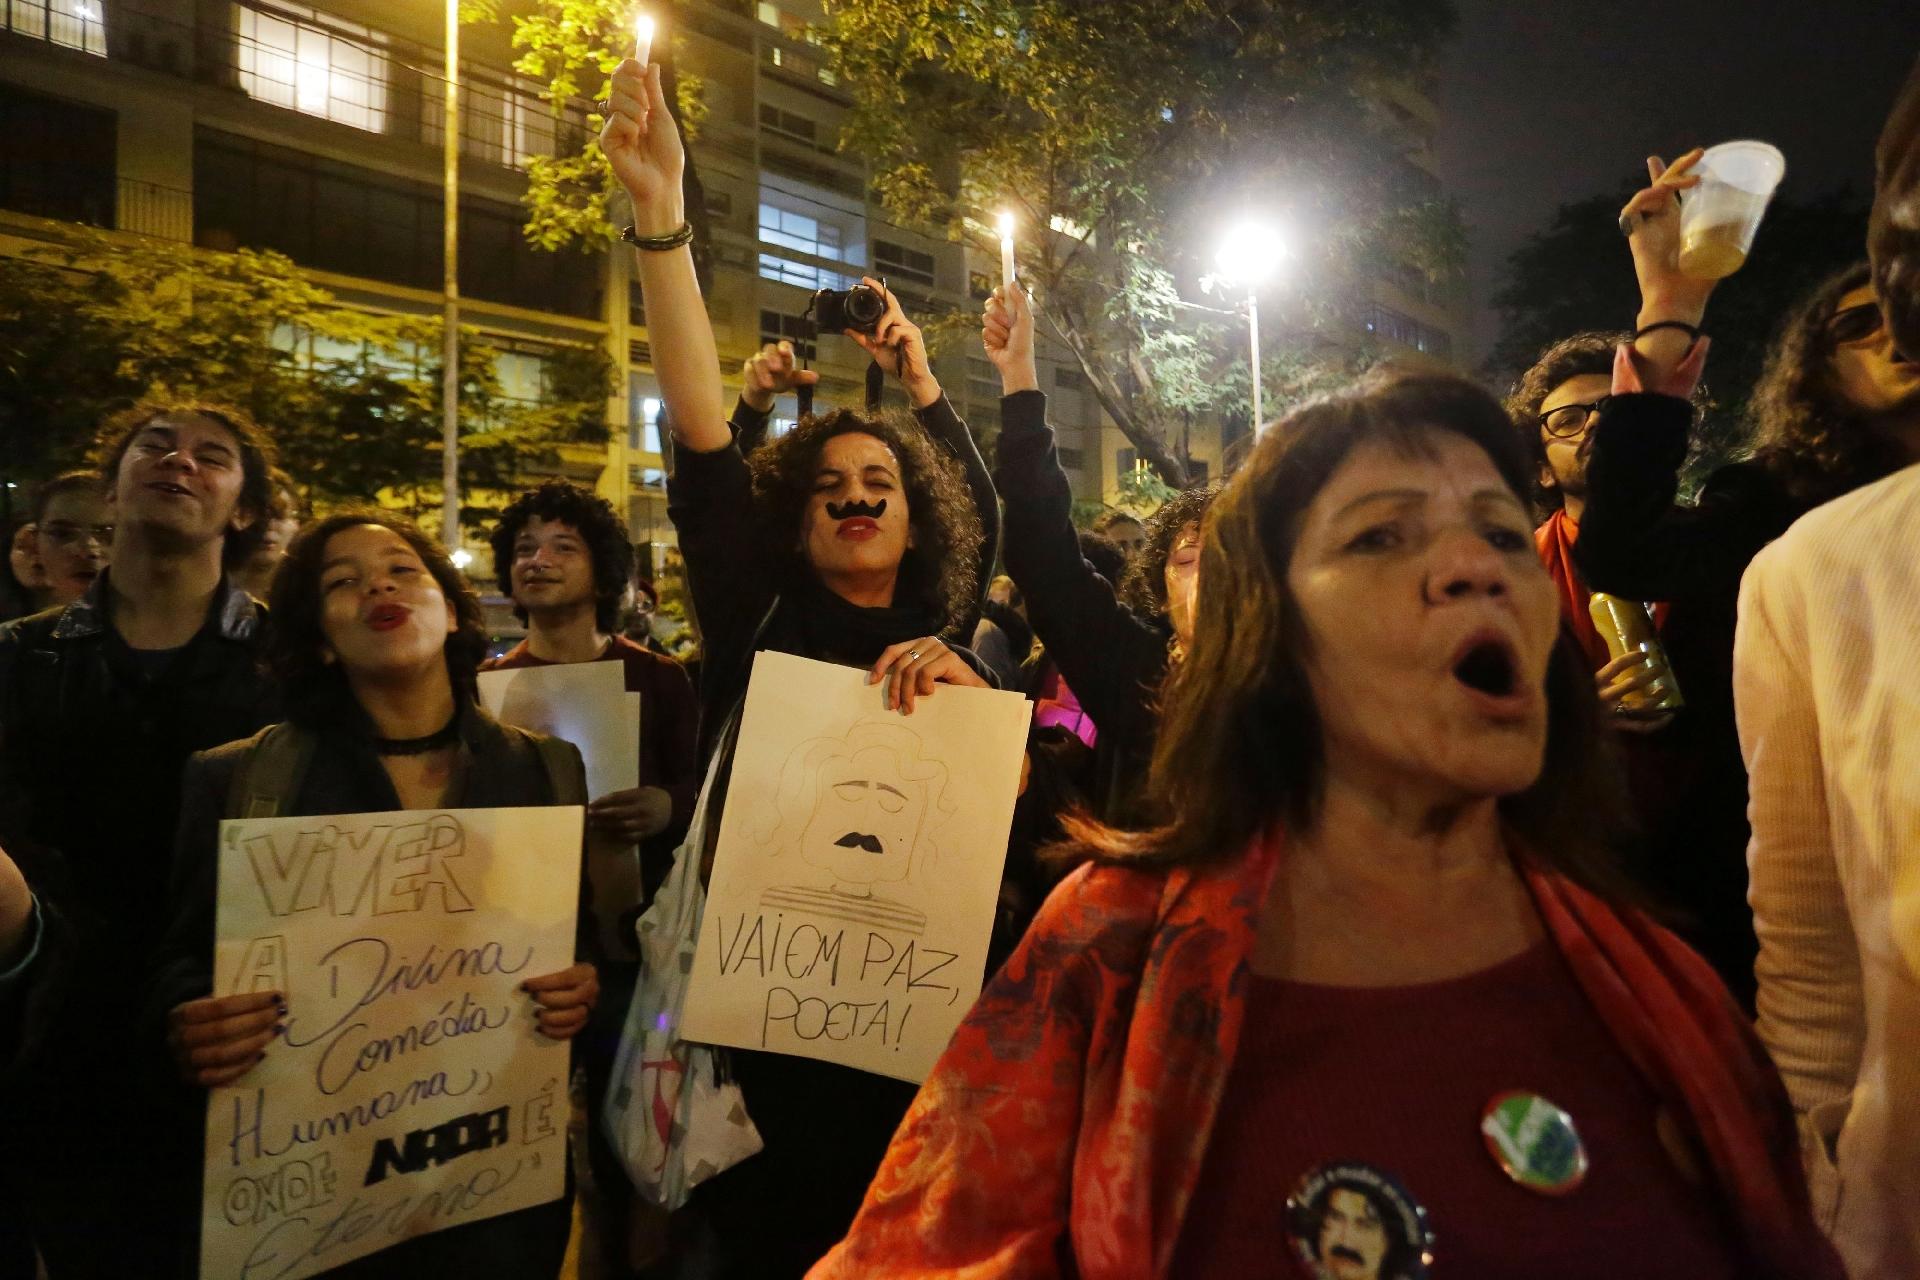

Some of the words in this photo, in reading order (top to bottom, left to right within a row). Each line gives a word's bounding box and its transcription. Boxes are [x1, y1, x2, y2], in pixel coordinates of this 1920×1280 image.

[285, 937, 534, 1048] Divina
[316, 993, 511, 1095] Comédia
[222, 1150, 338, 1226] ONDE
[364, 1104, 511, 1187] NADA
[521, 1077, 559, 1146] É
